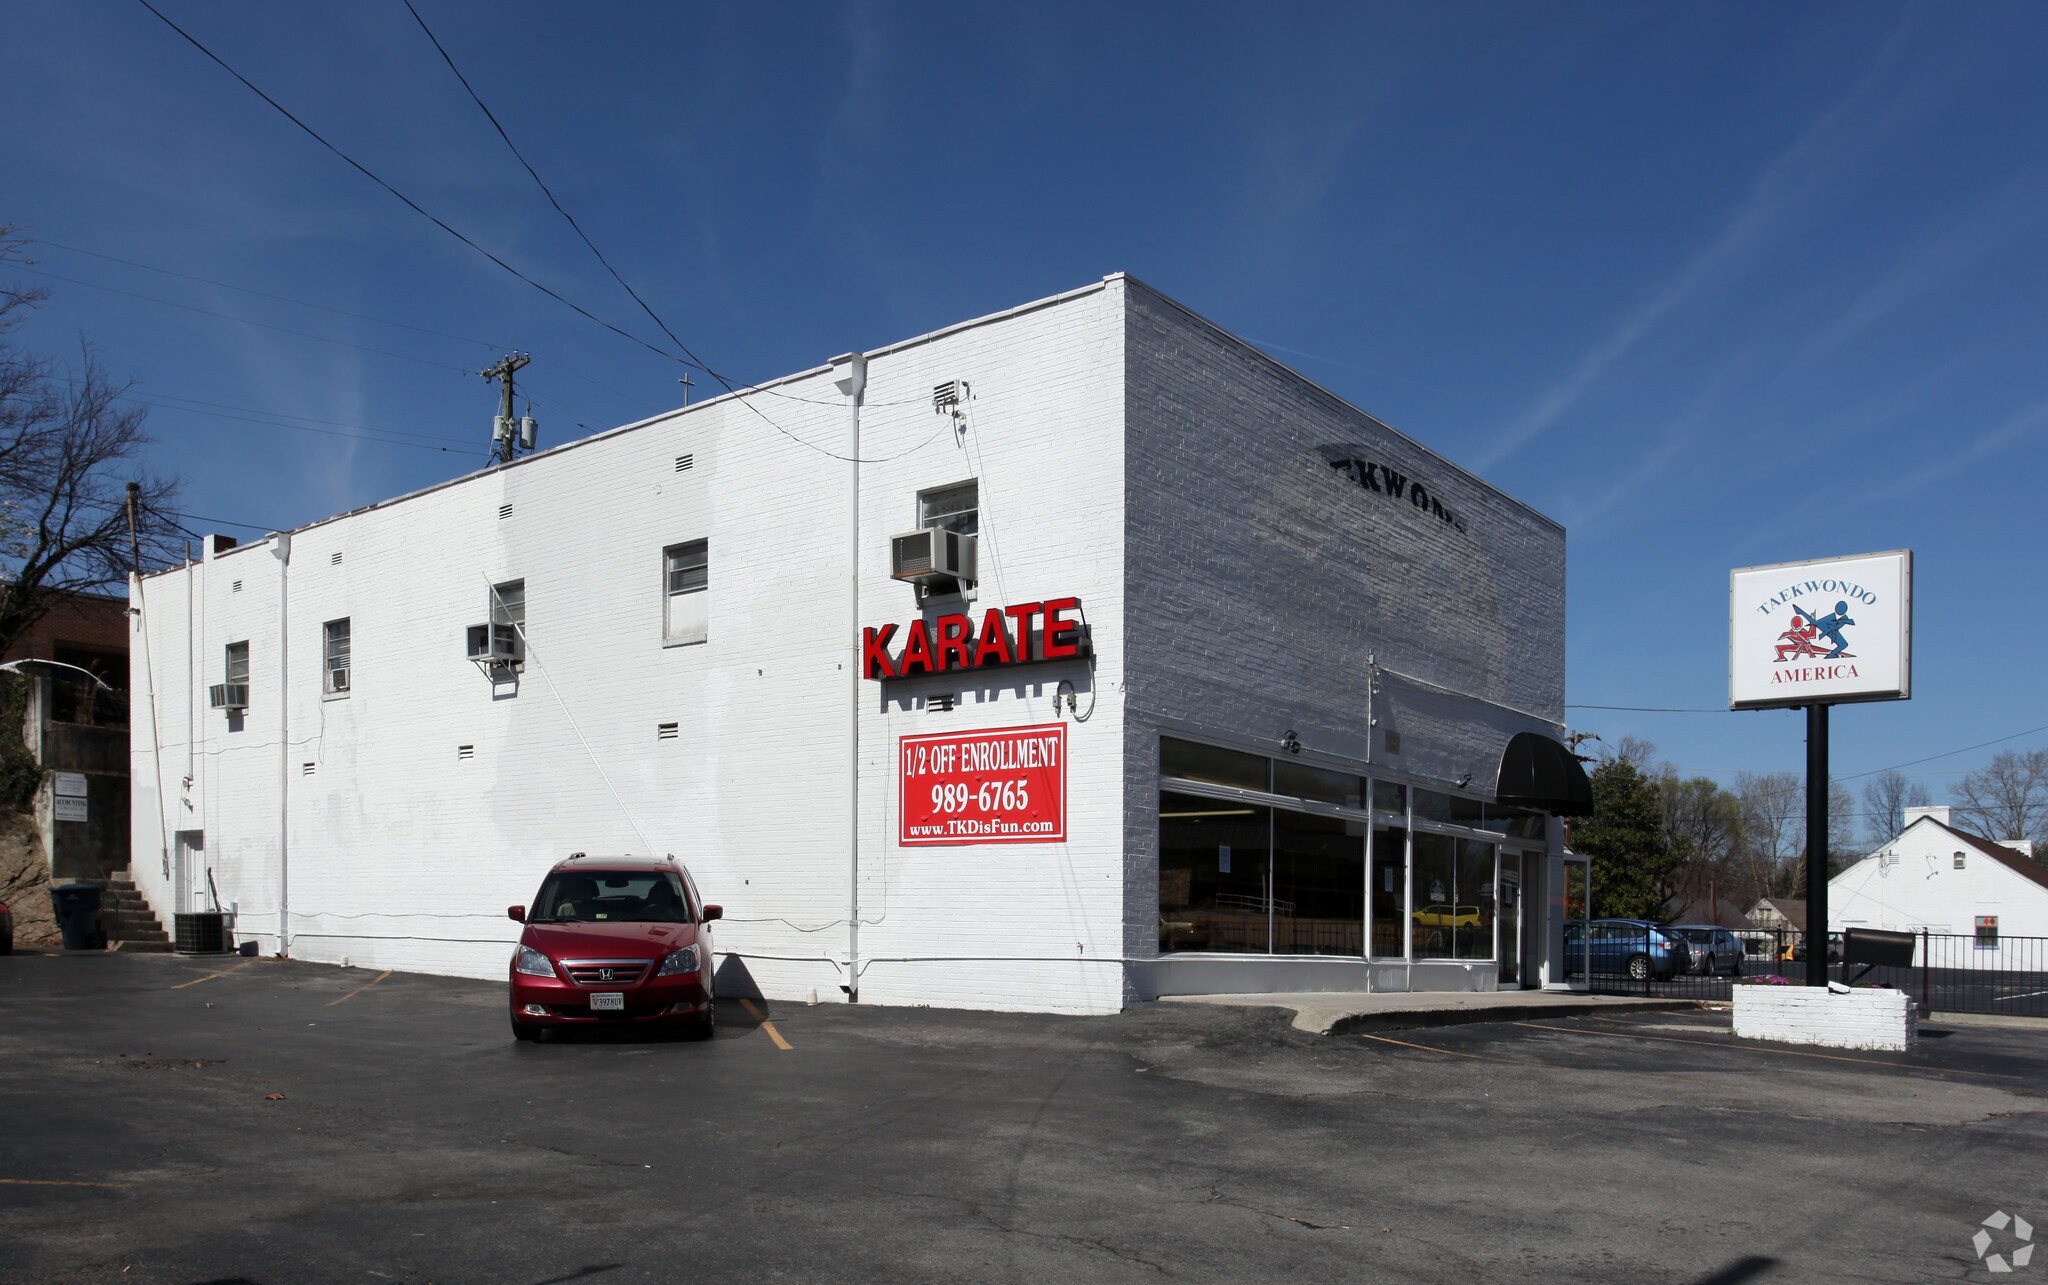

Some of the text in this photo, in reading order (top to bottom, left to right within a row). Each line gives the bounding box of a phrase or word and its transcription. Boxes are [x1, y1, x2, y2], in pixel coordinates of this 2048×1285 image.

[1757, 579, 1877, 616] TAEKWONDO
[863, 597, 1079, 680] KARATE
[1771, 664, 1859, 684] AMERICA
[906, 737, 1058, 778] 1/2 OFF ENROLLMENT
[931, 780, 1029, 814] 989-6765
[910, 819, 1054, 836] www.TKDisFun.com
